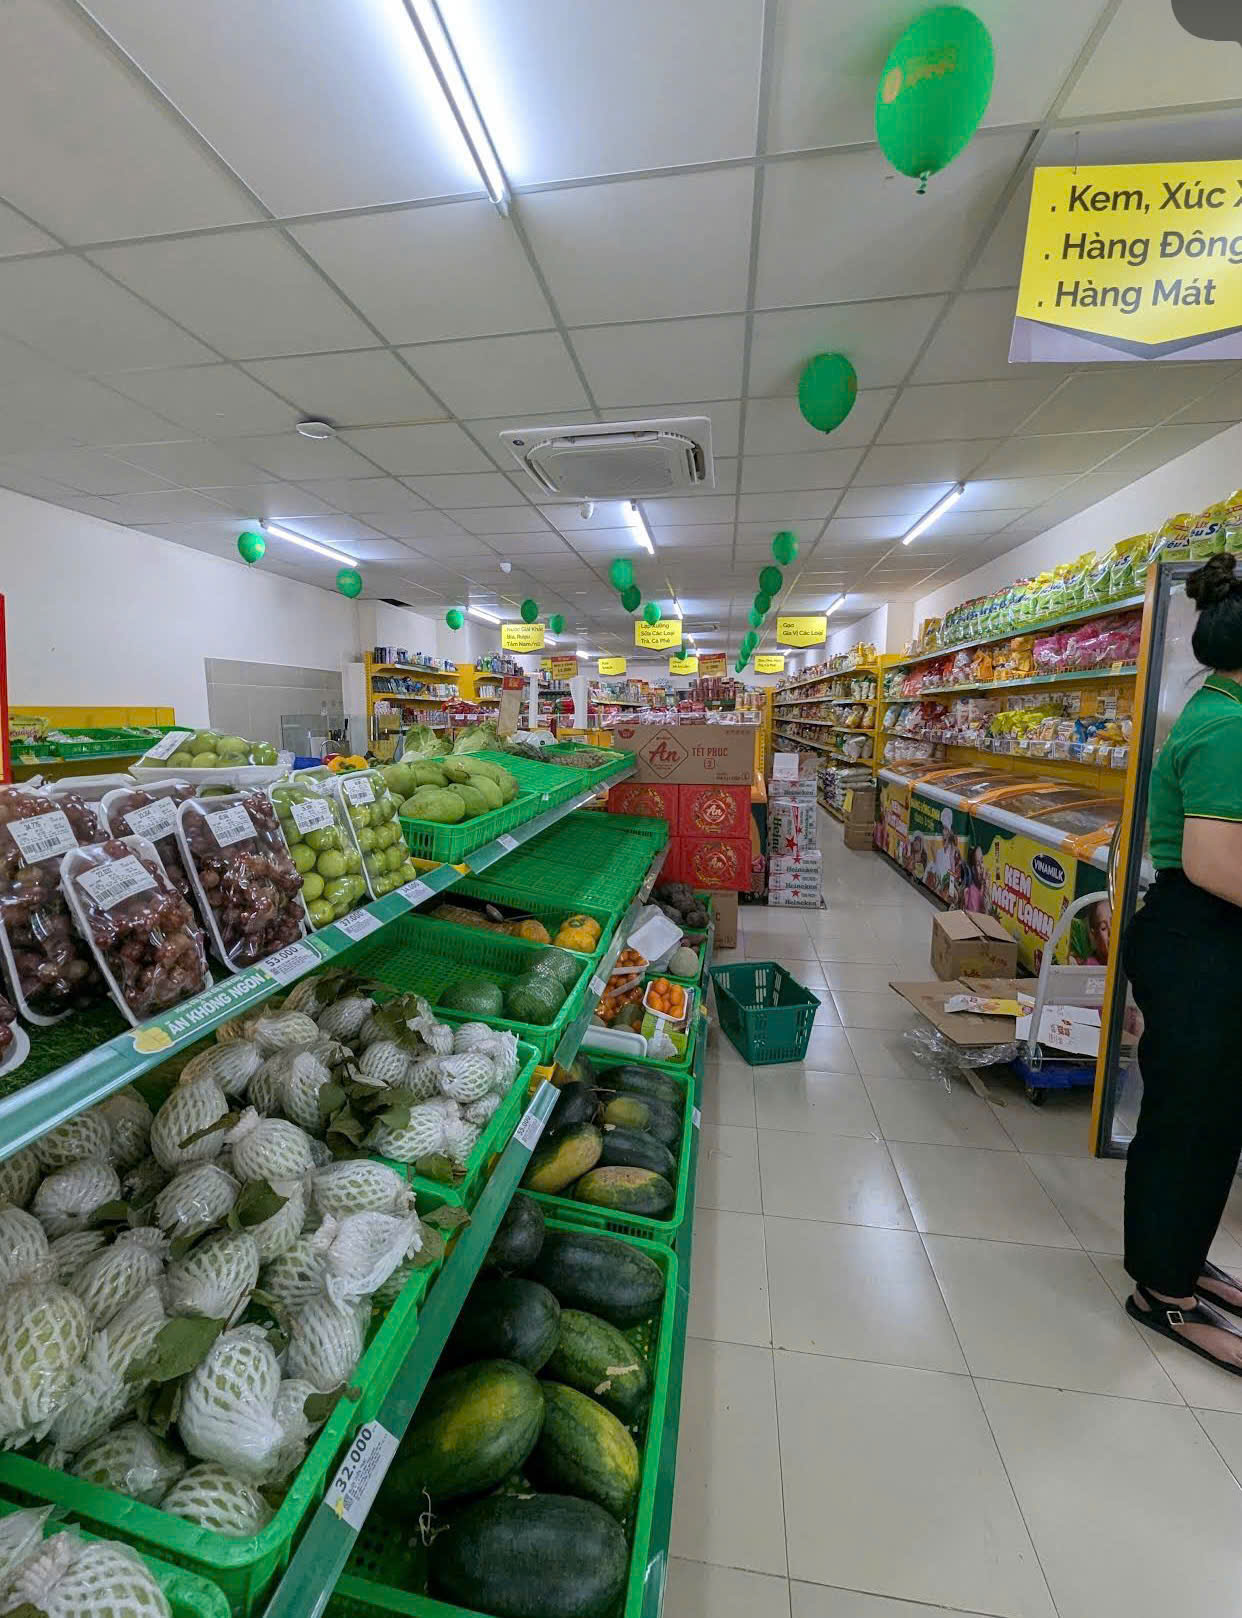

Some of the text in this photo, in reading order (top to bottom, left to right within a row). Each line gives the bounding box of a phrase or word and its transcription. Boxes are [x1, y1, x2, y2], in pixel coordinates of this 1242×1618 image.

[1068, 184, 1150, 214] Kem,
[1159, 180, 1226, 210] Xúc
[1061, 229, 1242, 267] Hàng Đông
[1054, 278, 1217, 315] Hàng Mát
[648, 740, 680, 764] An
[1004, 863, 1032, 898] KEM
[1034, 858, 1065, 882] VINAMILK
[265, 945, 299, 967] 53.000
[185, 993, 233, 1024] KHÔNG
[335, 1427, 373, 1494] 32.000
